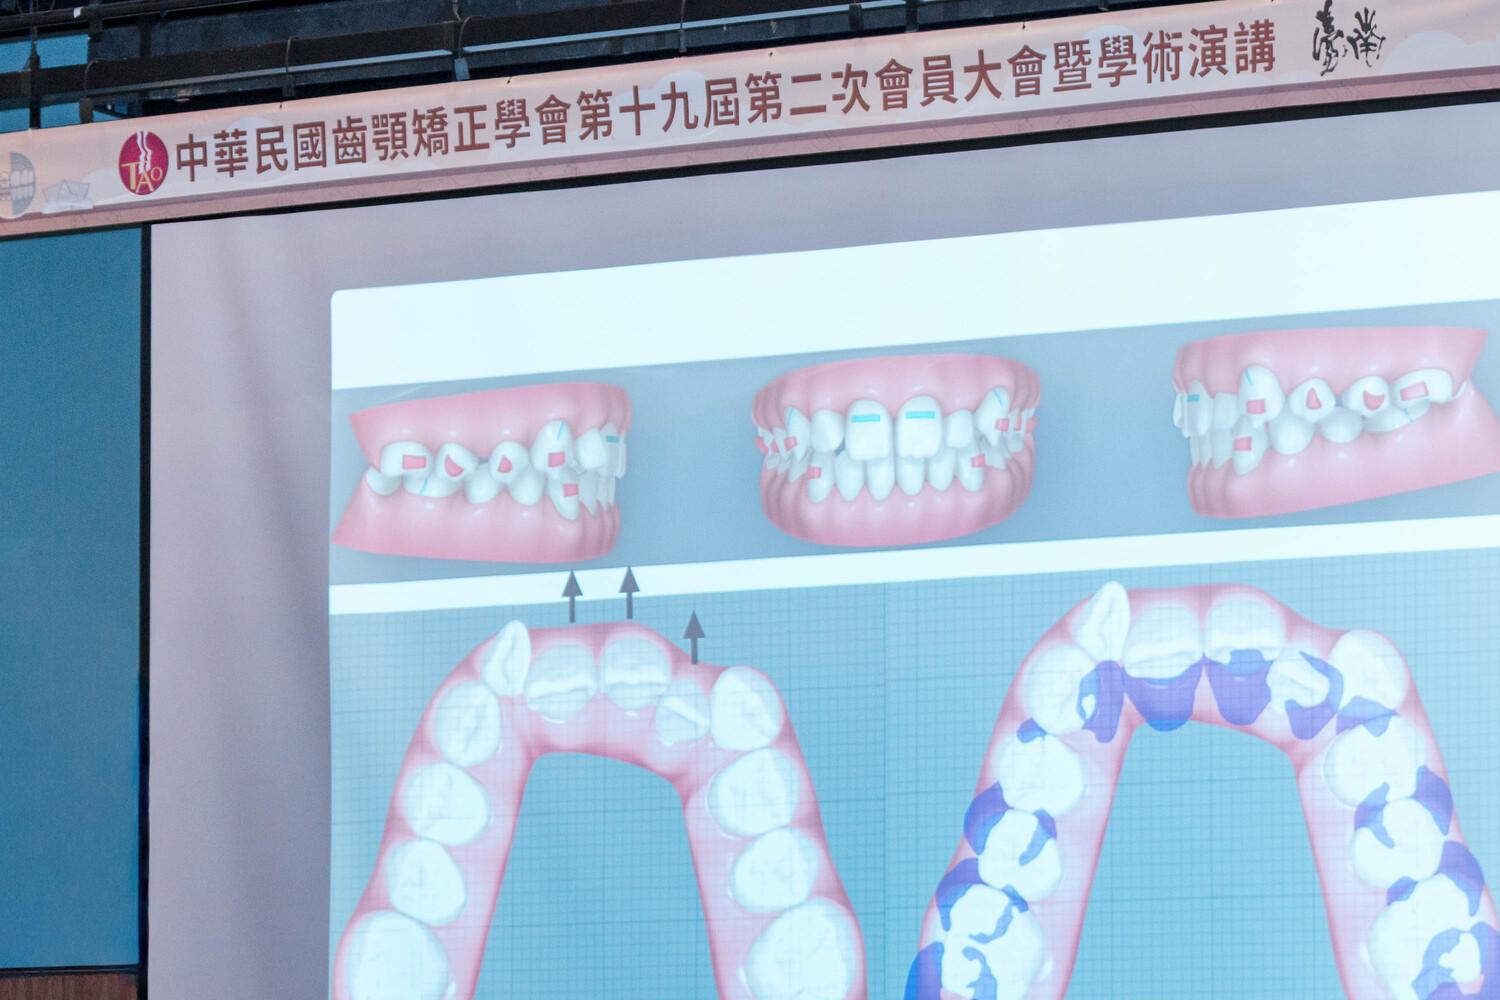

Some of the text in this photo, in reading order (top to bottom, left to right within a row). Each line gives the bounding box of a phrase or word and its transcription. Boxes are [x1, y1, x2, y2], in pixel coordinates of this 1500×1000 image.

[176, 20, 1278, 183] 中華民國齒顎矯正學會第十九屆第二次會員大會暨學術演講
